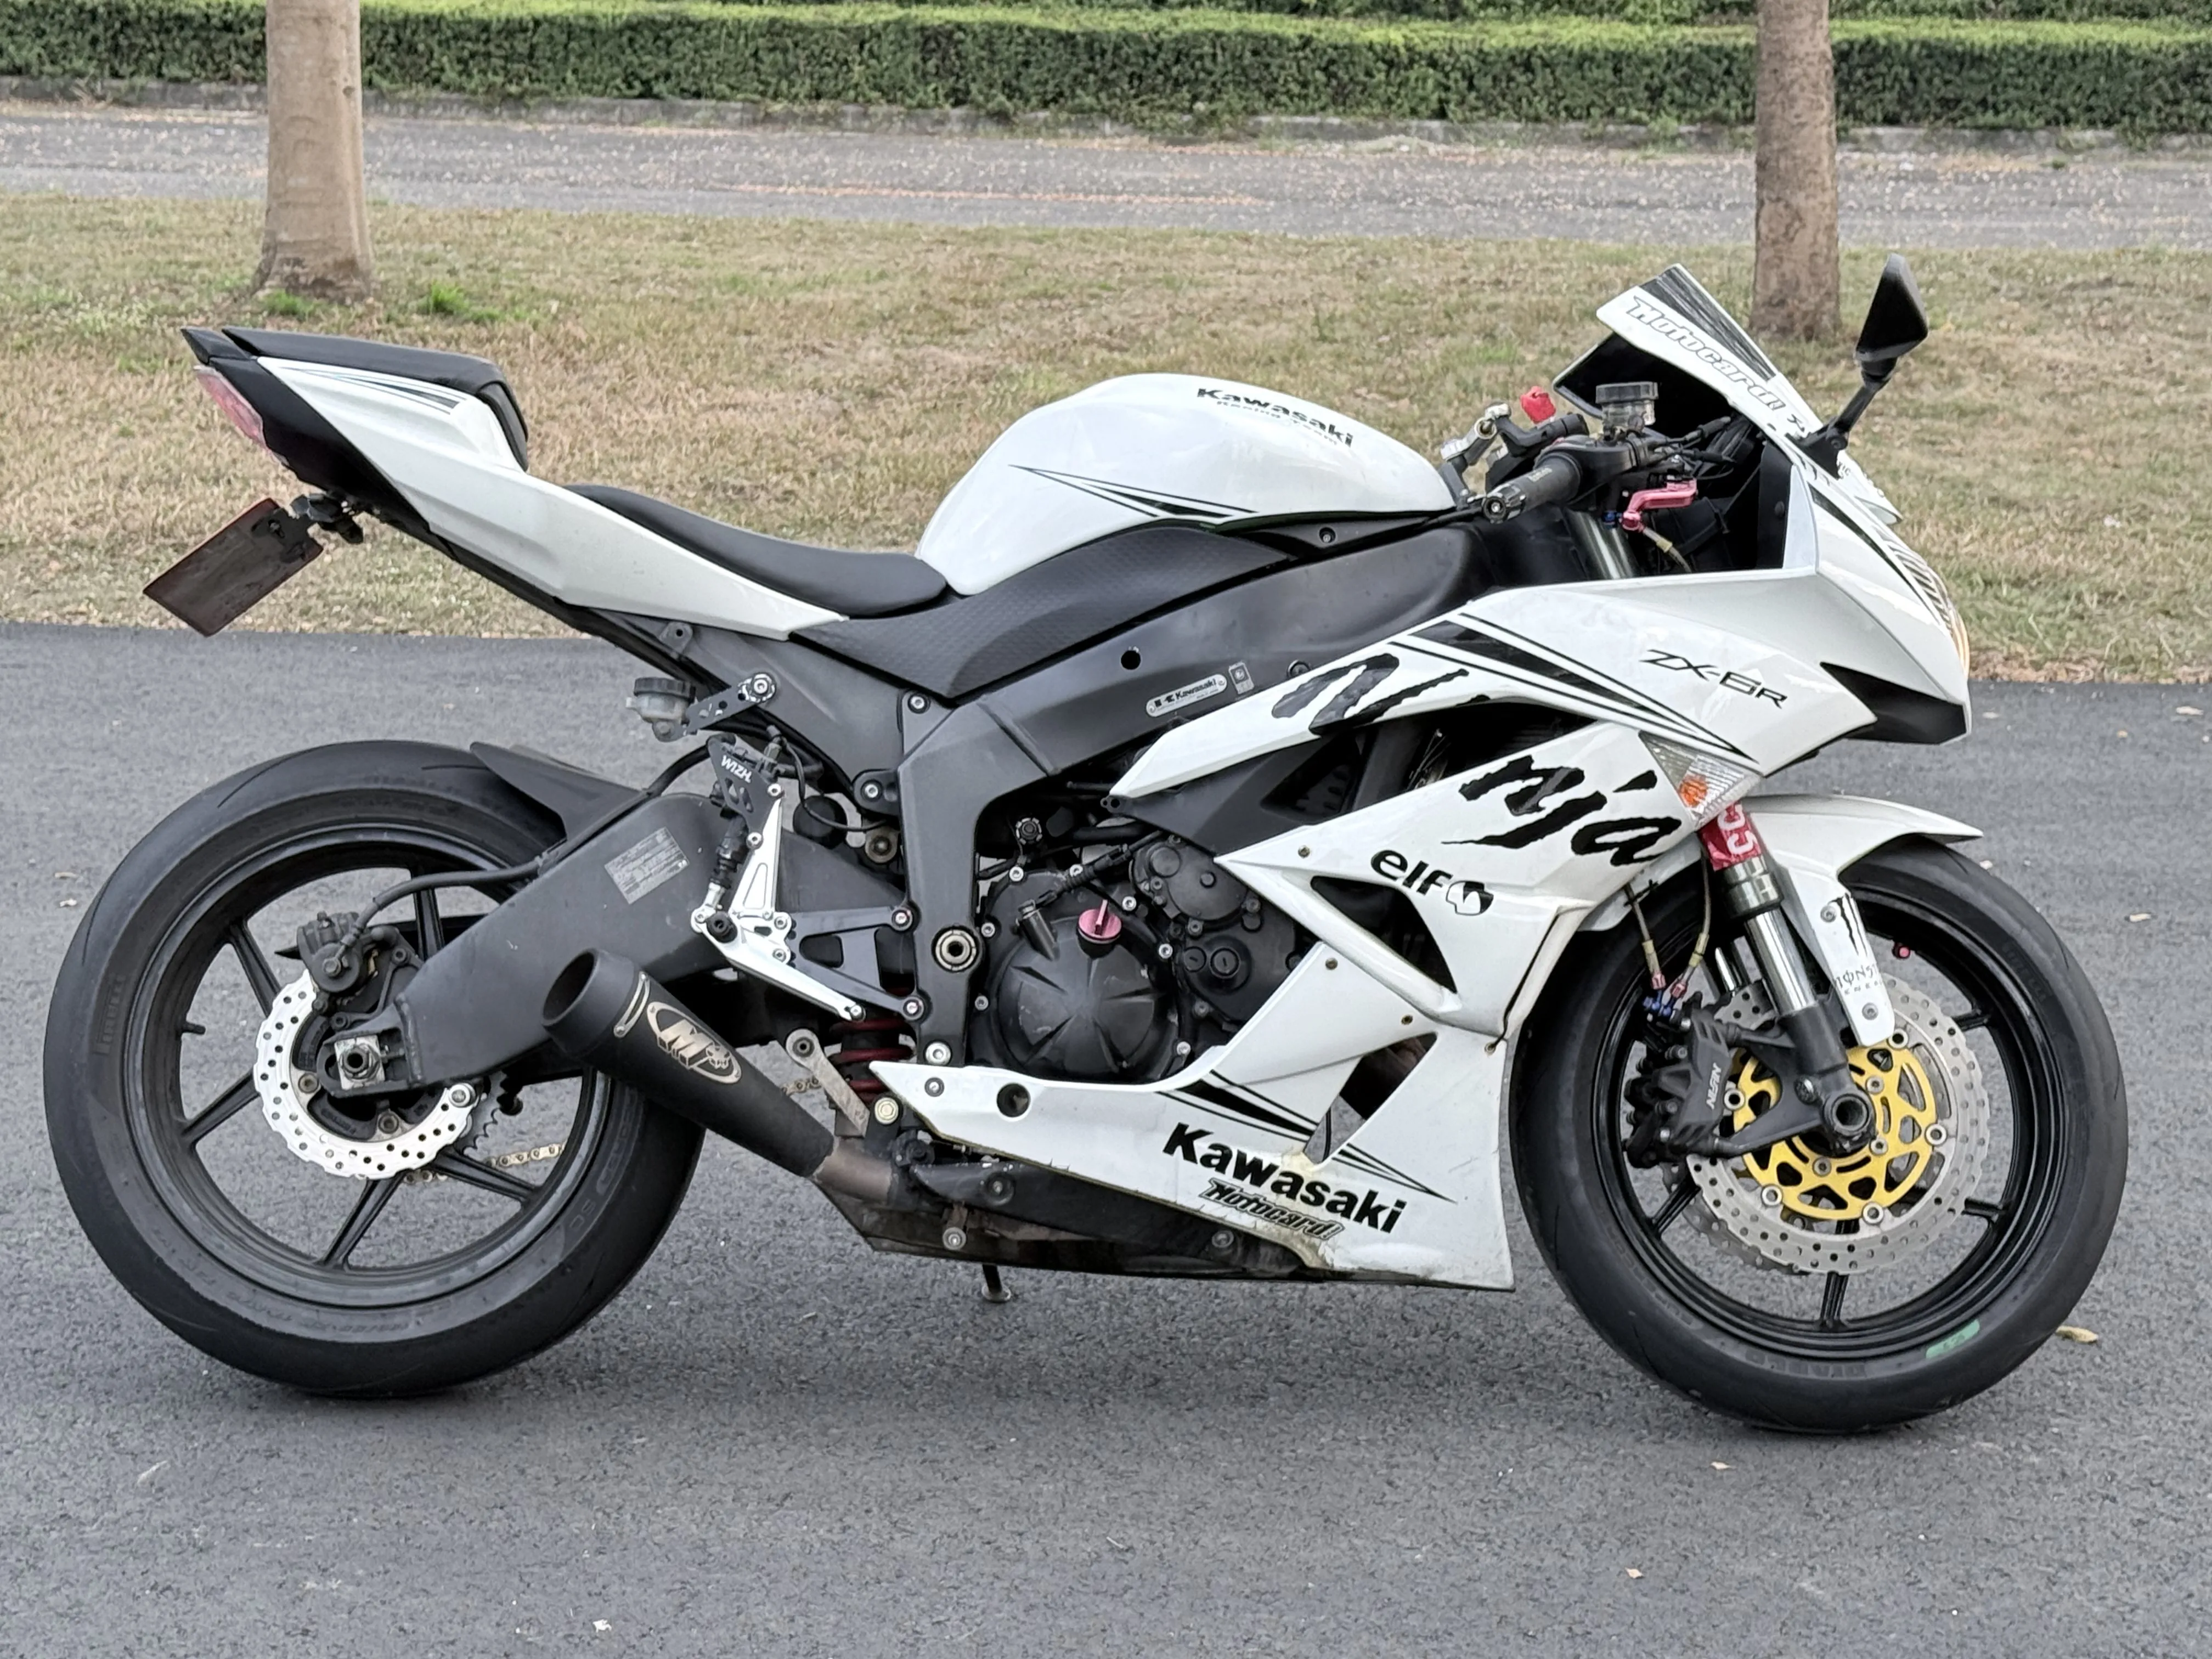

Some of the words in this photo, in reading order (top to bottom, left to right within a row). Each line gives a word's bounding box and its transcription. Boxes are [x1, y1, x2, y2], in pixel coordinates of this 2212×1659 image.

[1197, 388, 1353, 448] Kawasaki
[1175, 678, 1217, 701] Kawasaki
[1639, 649, 1788, 709] ZX-6R
[1370, 849, 1453, 895] elf
[1163, 1122, 1407, 1234] Kawasaki
[1198, 1177, 1345, 1240] Motocard!
